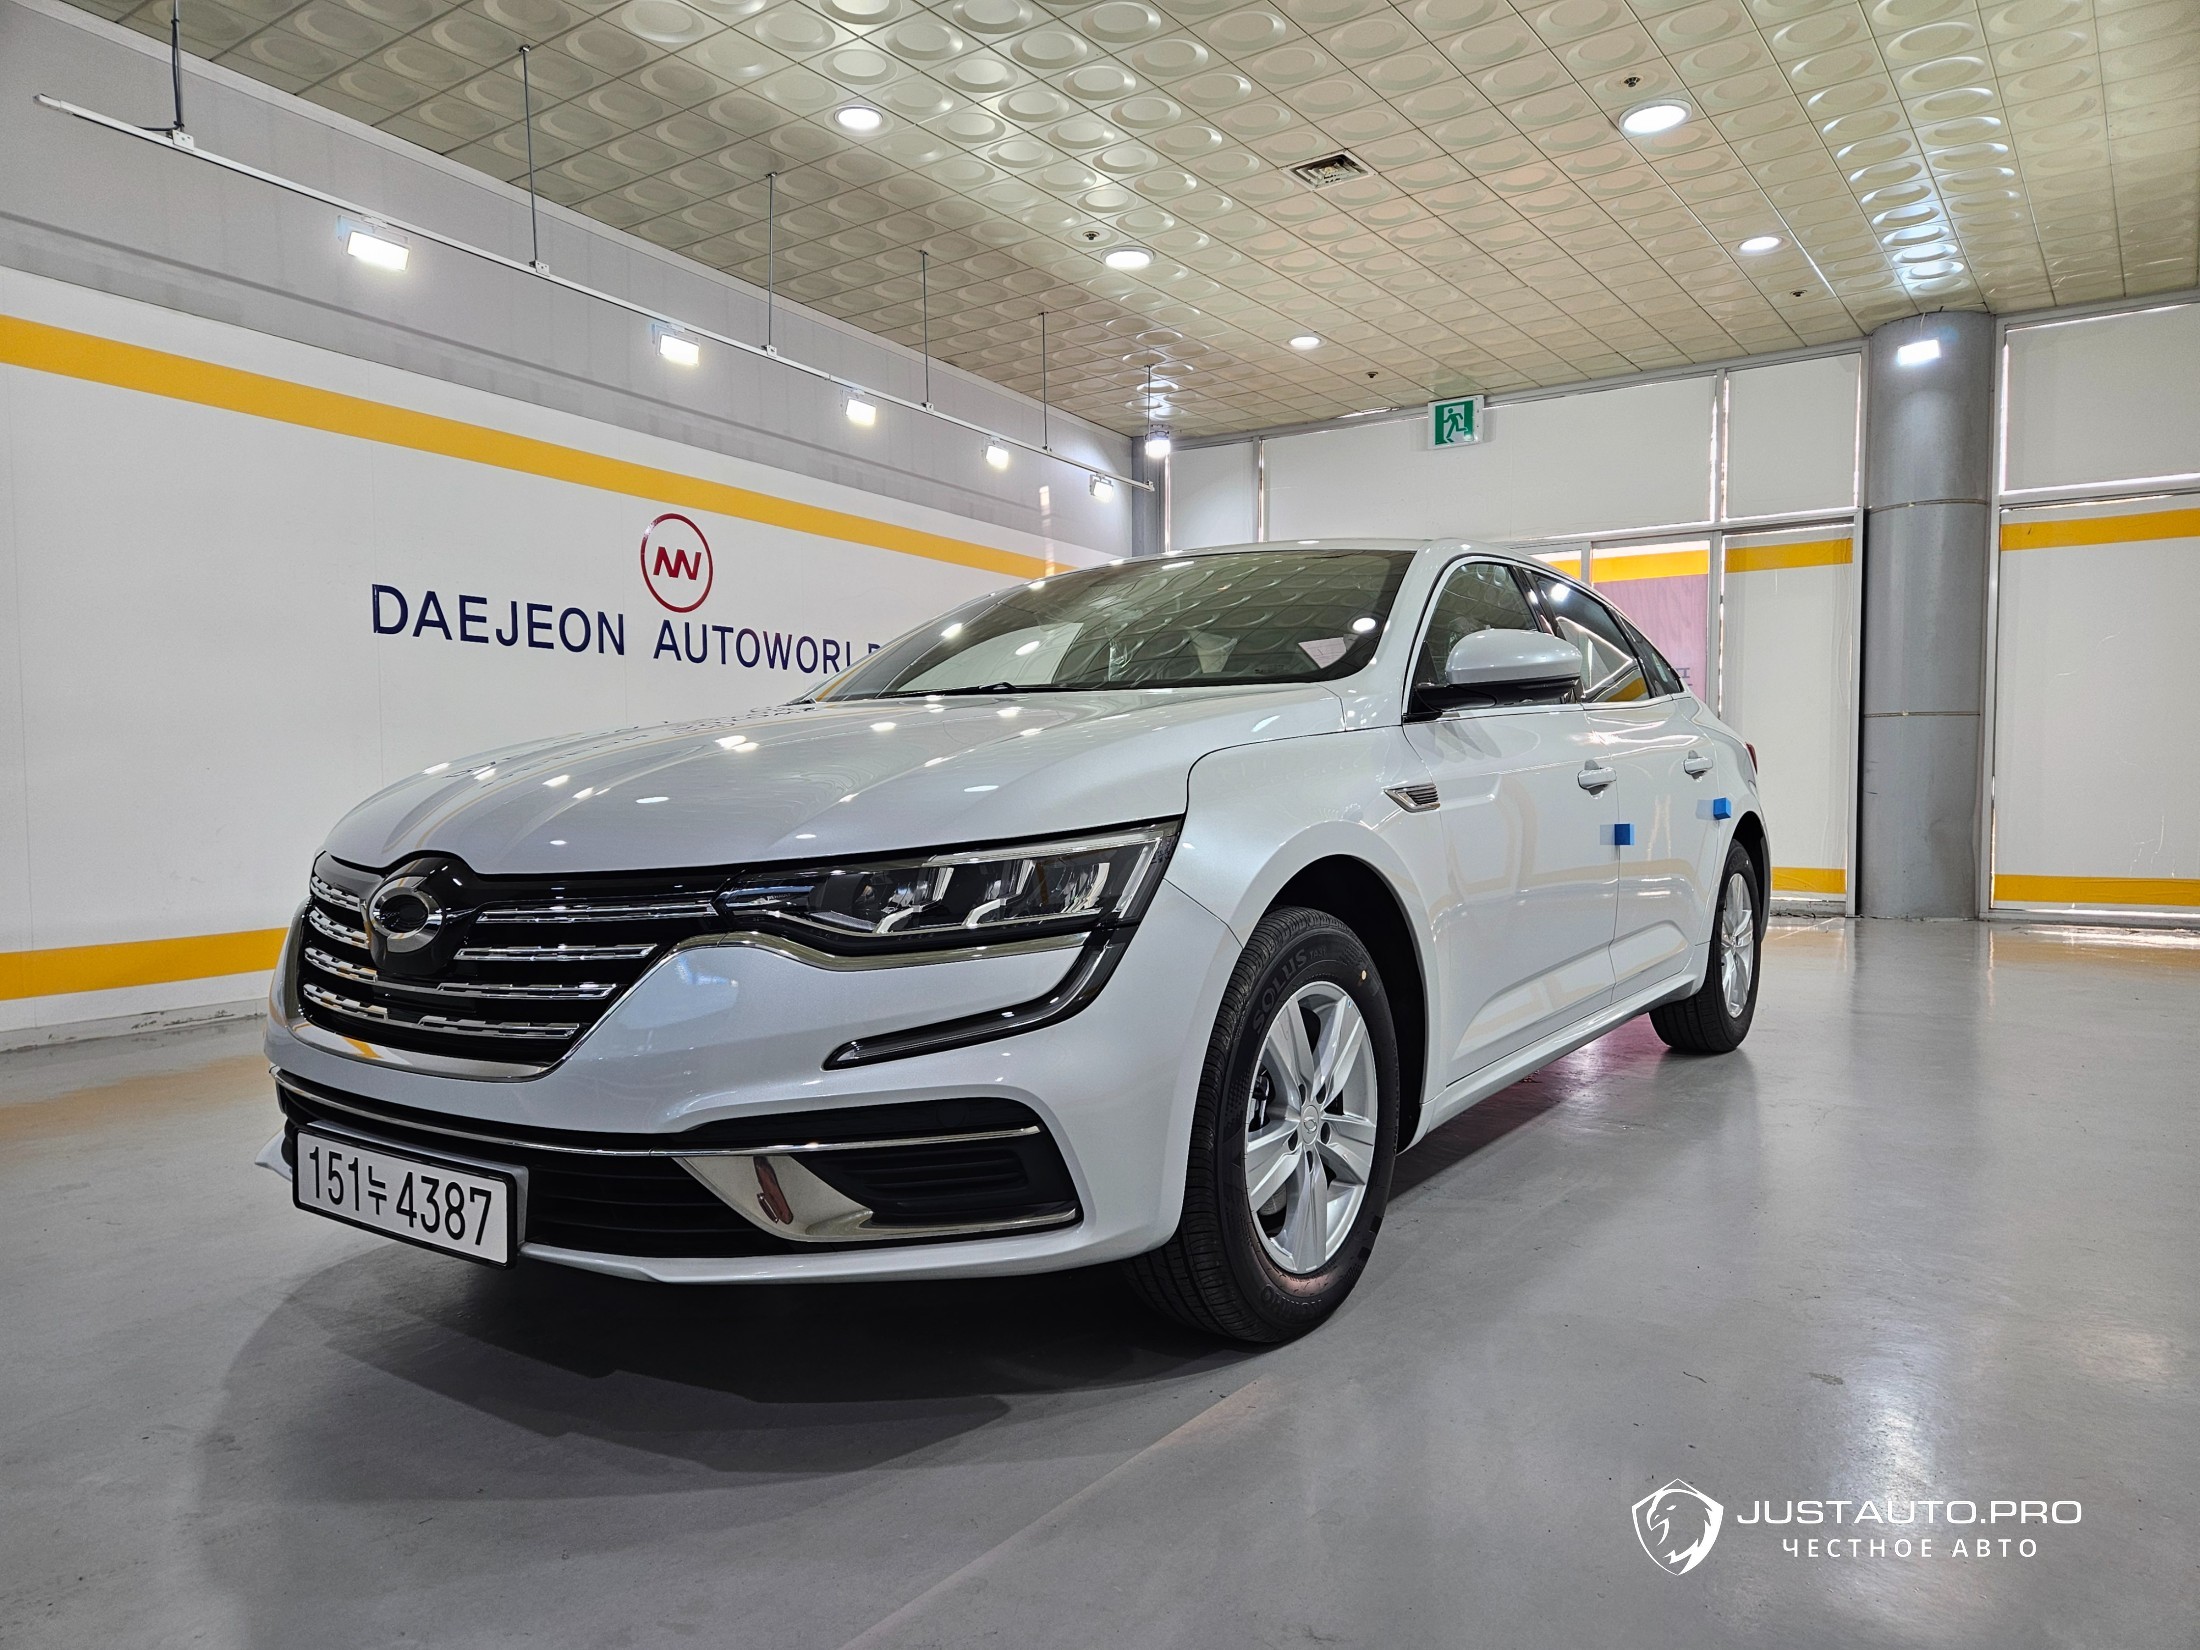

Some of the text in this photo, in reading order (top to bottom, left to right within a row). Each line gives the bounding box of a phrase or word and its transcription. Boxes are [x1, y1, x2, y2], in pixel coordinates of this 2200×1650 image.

[372, 583, 881, 676] DAEJEON AUTOWORL
[1252, 948, 1307, 1034] SOLUS
[309, 1146, 492, 1246] 151누4387
